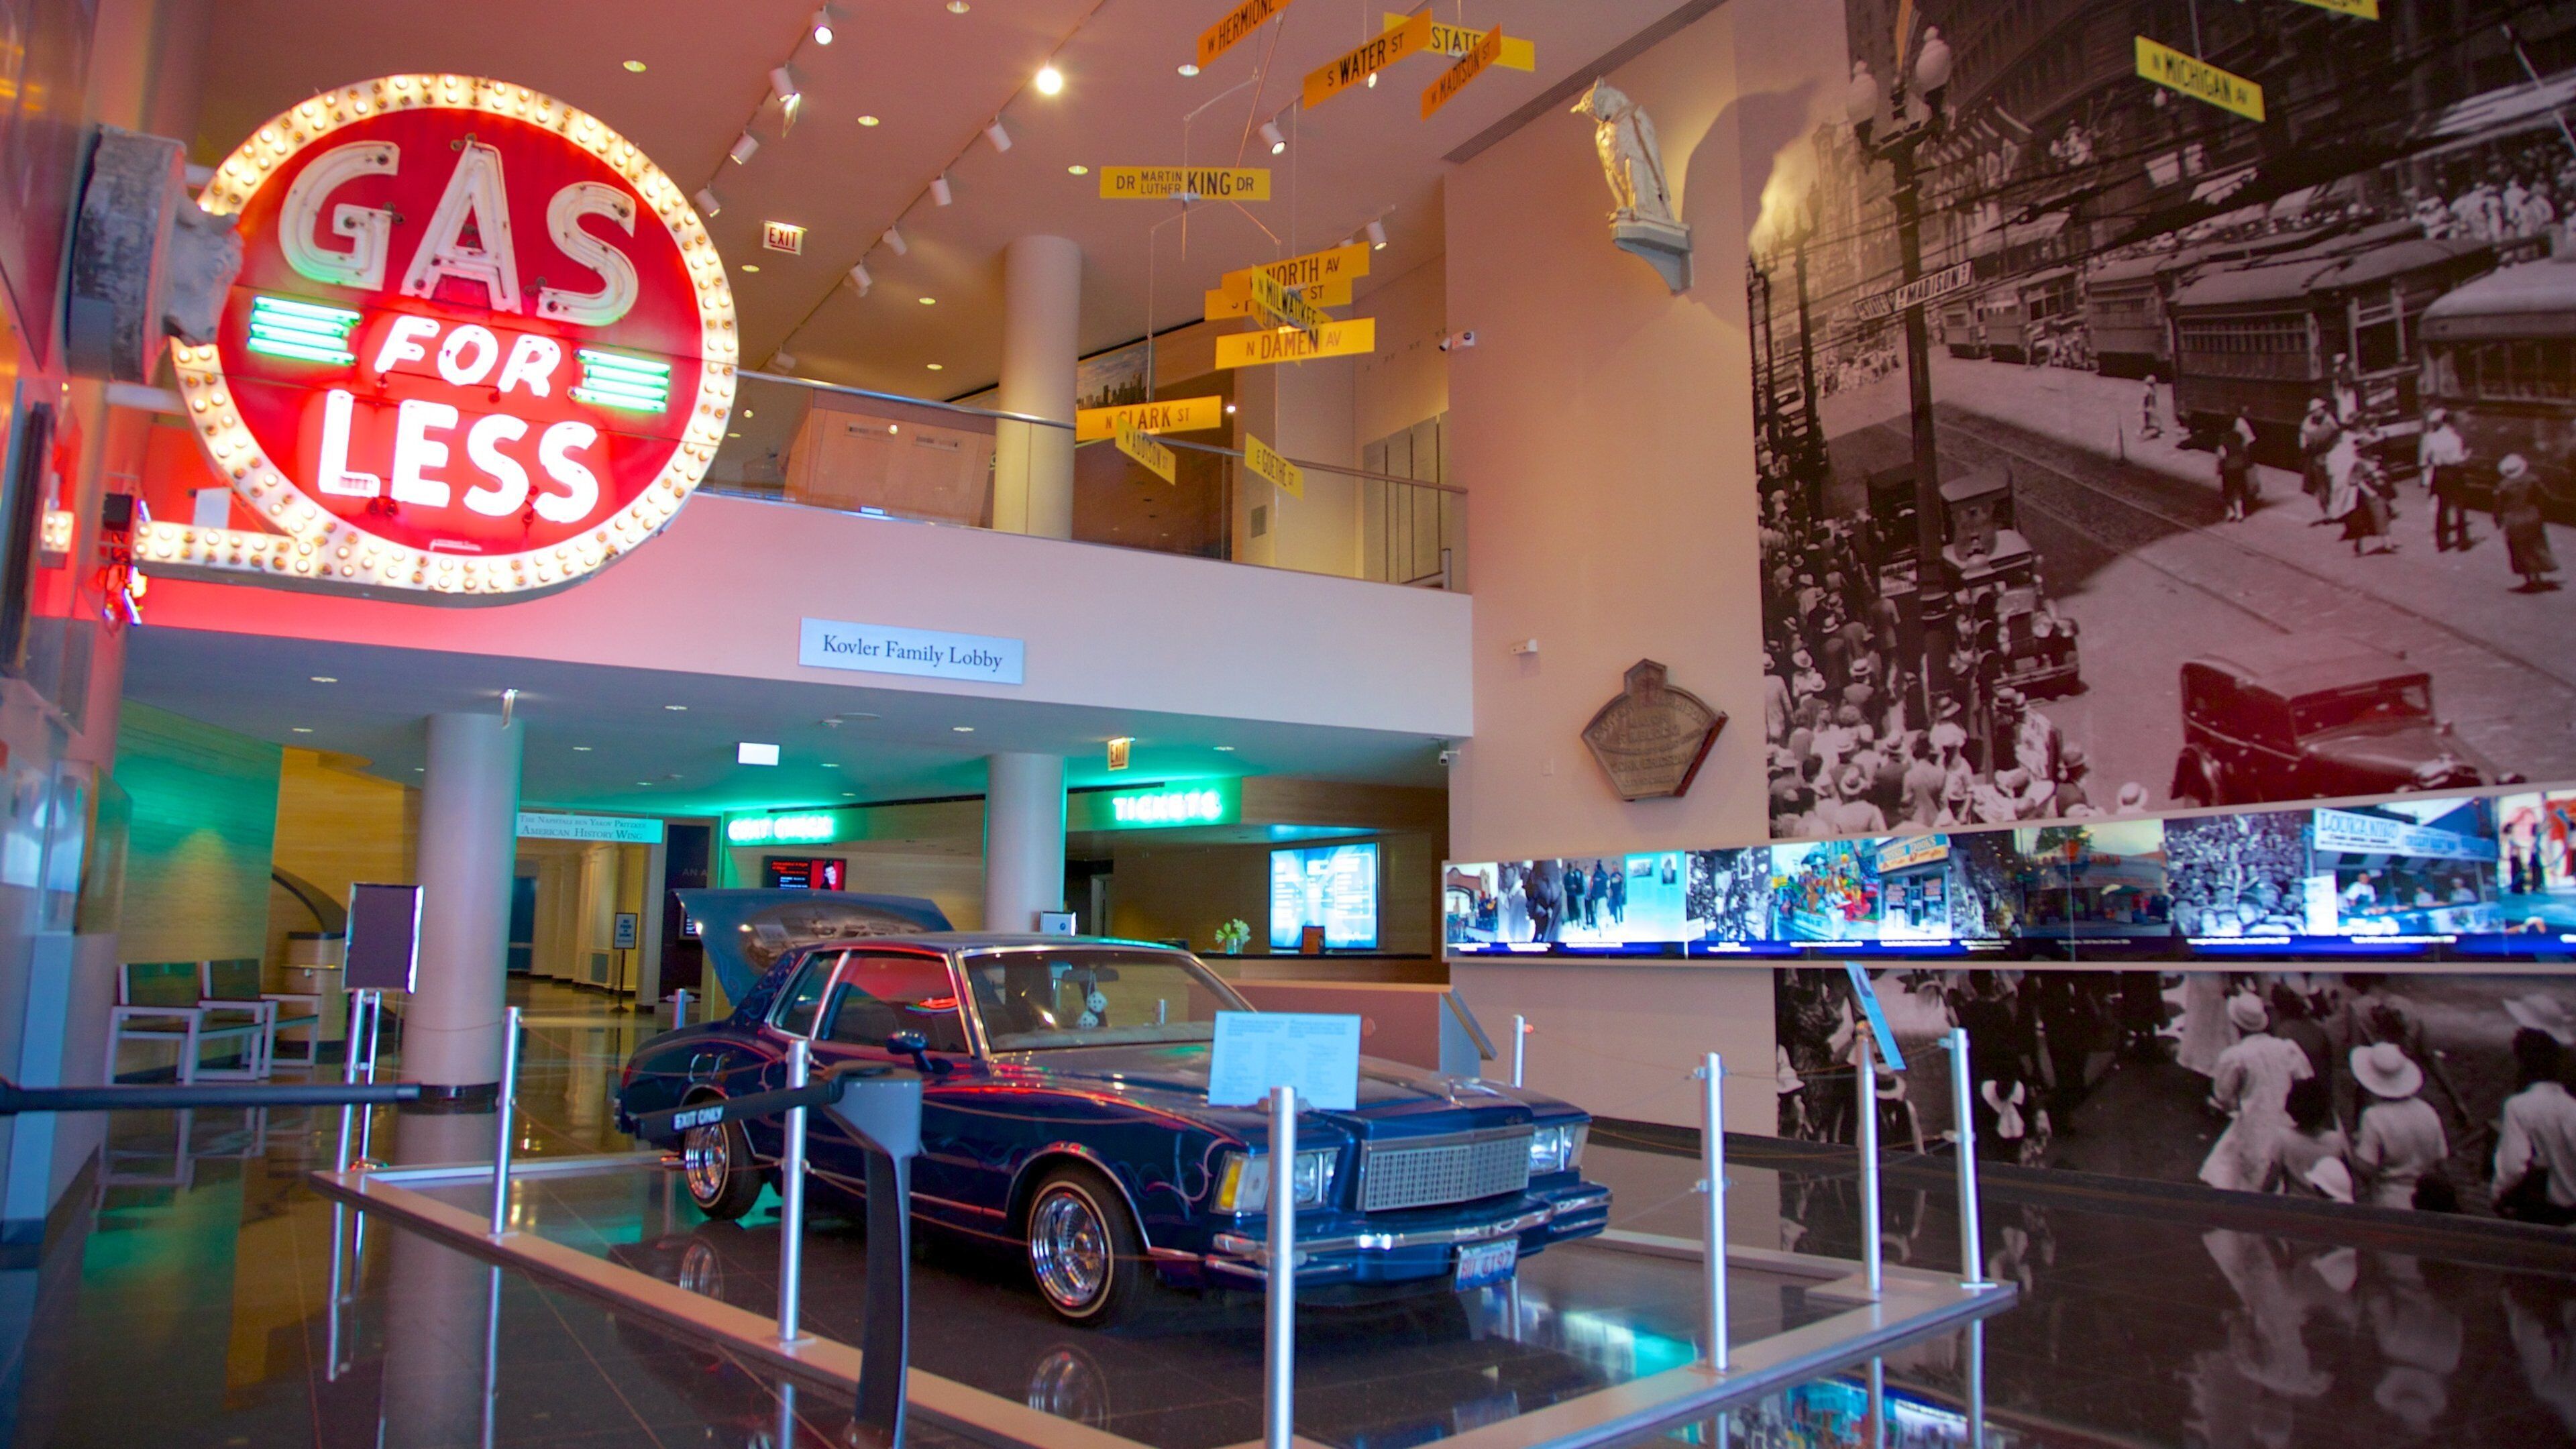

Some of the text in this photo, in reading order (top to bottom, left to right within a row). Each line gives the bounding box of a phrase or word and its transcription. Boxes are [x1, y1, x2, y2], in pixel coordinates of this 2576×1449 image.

[1328, 32, 1405, 87] S WATER ST
[1439, 48, 1481, 103] MADISON
[1483, 42, 1491, 60] ST
[2164, 52, 2232, 103] MICHIGAN
[1116, 171, 1254, 195] DR MARTIN LUTHER KING DR
[278, 138, 640, 326] GAS
[769, 227, 797, 248] EXIT
[1326, 256, 1340, 274] AV
[1311, 285, 1325, 300] ST
[1907, 269, 1959, 301] MADISON
[374, 315, 563, 398] FOR
[1246, 329, 1342, 360] N DAMEN AV
[1106, 415, 1112, 429] N
[1177, 407, 1191, 422] ST
[317, 390, 599, 524] LESS
[823, 634, 1003, 672] Kovler Family Lobby
[1111, 742, 1126, 763] EXIT
[1112, 790, 1223, 822] TICKETS
[521, 825, 643, 840] AMERICAN HISTORY WING
[675, 1106, 724, 1130] EXIT ONLY
